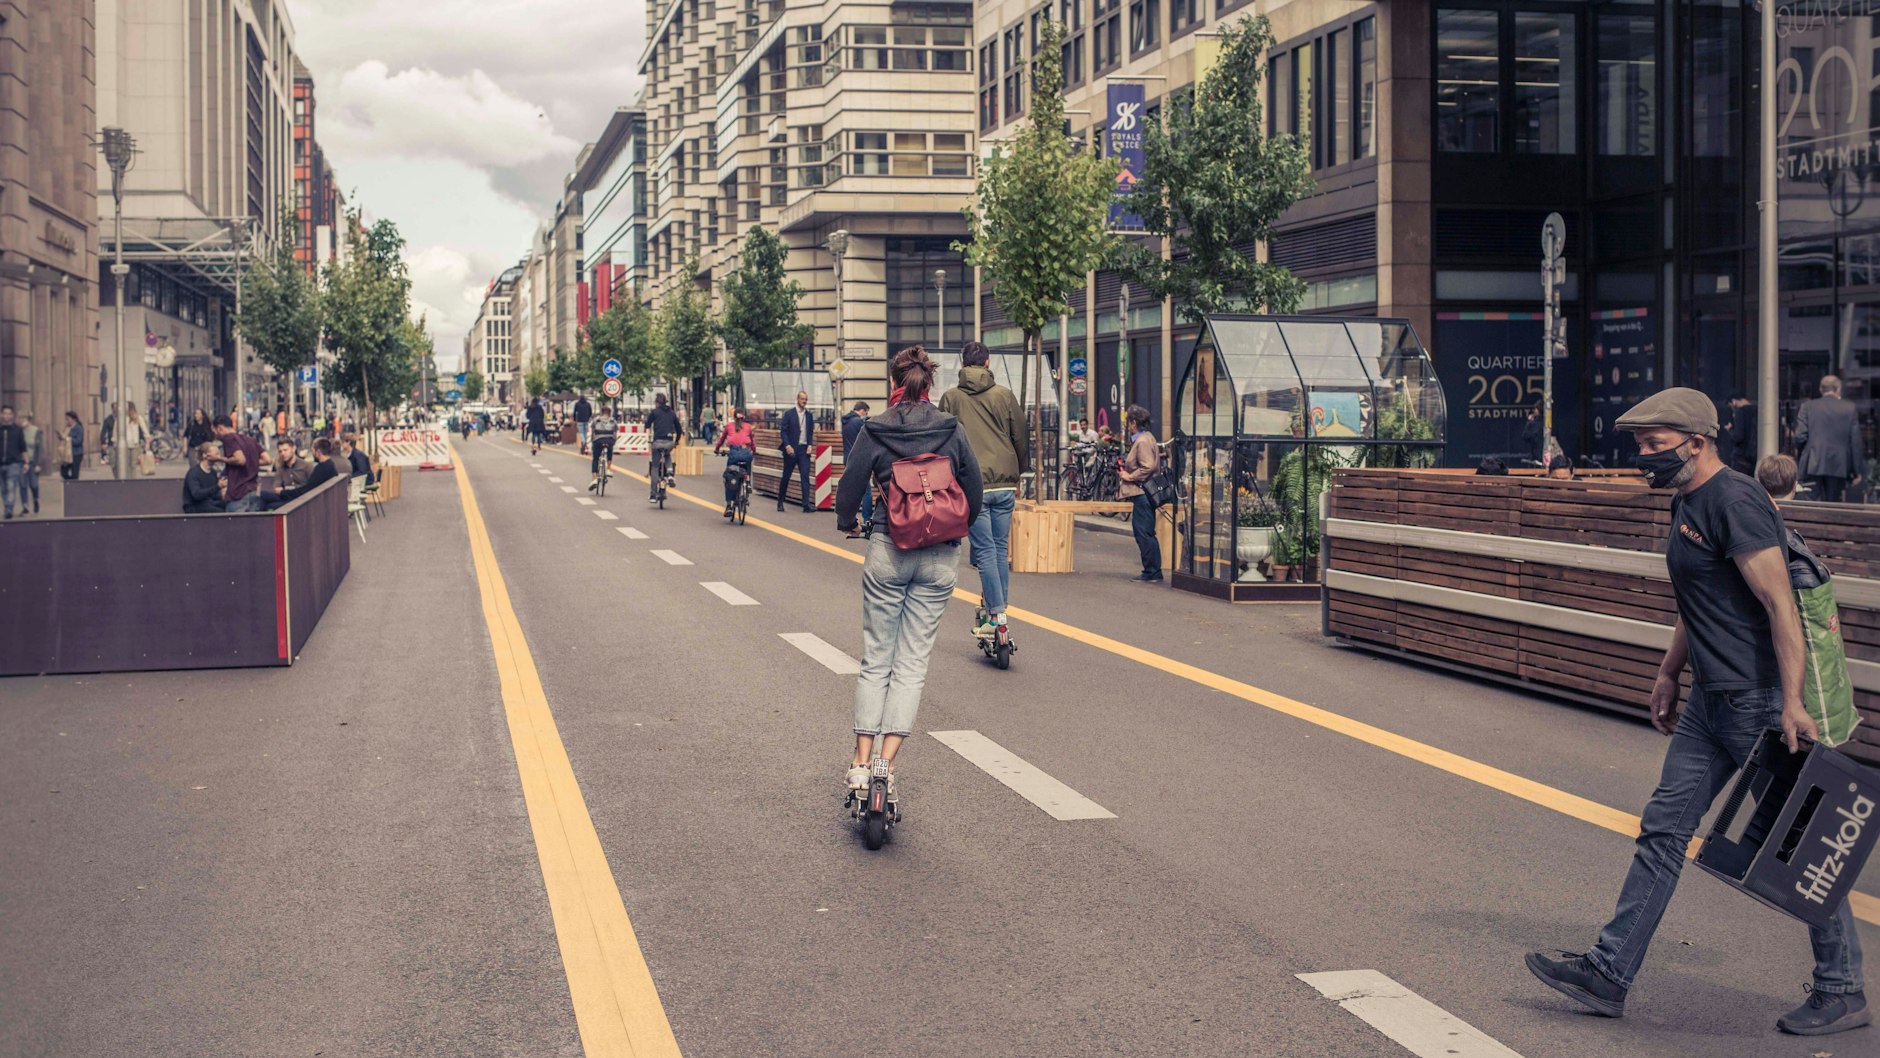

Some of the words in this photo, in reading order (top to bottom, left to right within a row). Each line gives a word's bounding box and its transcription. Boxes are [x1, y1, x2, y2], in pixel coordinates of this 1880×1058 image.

[303, 369, 313, 381] P
[608, 383, 617, 391] 20
[1468, 408, 1538, 419] STADTMIT
[1795, 794, 1876, 905] fritz-kola
